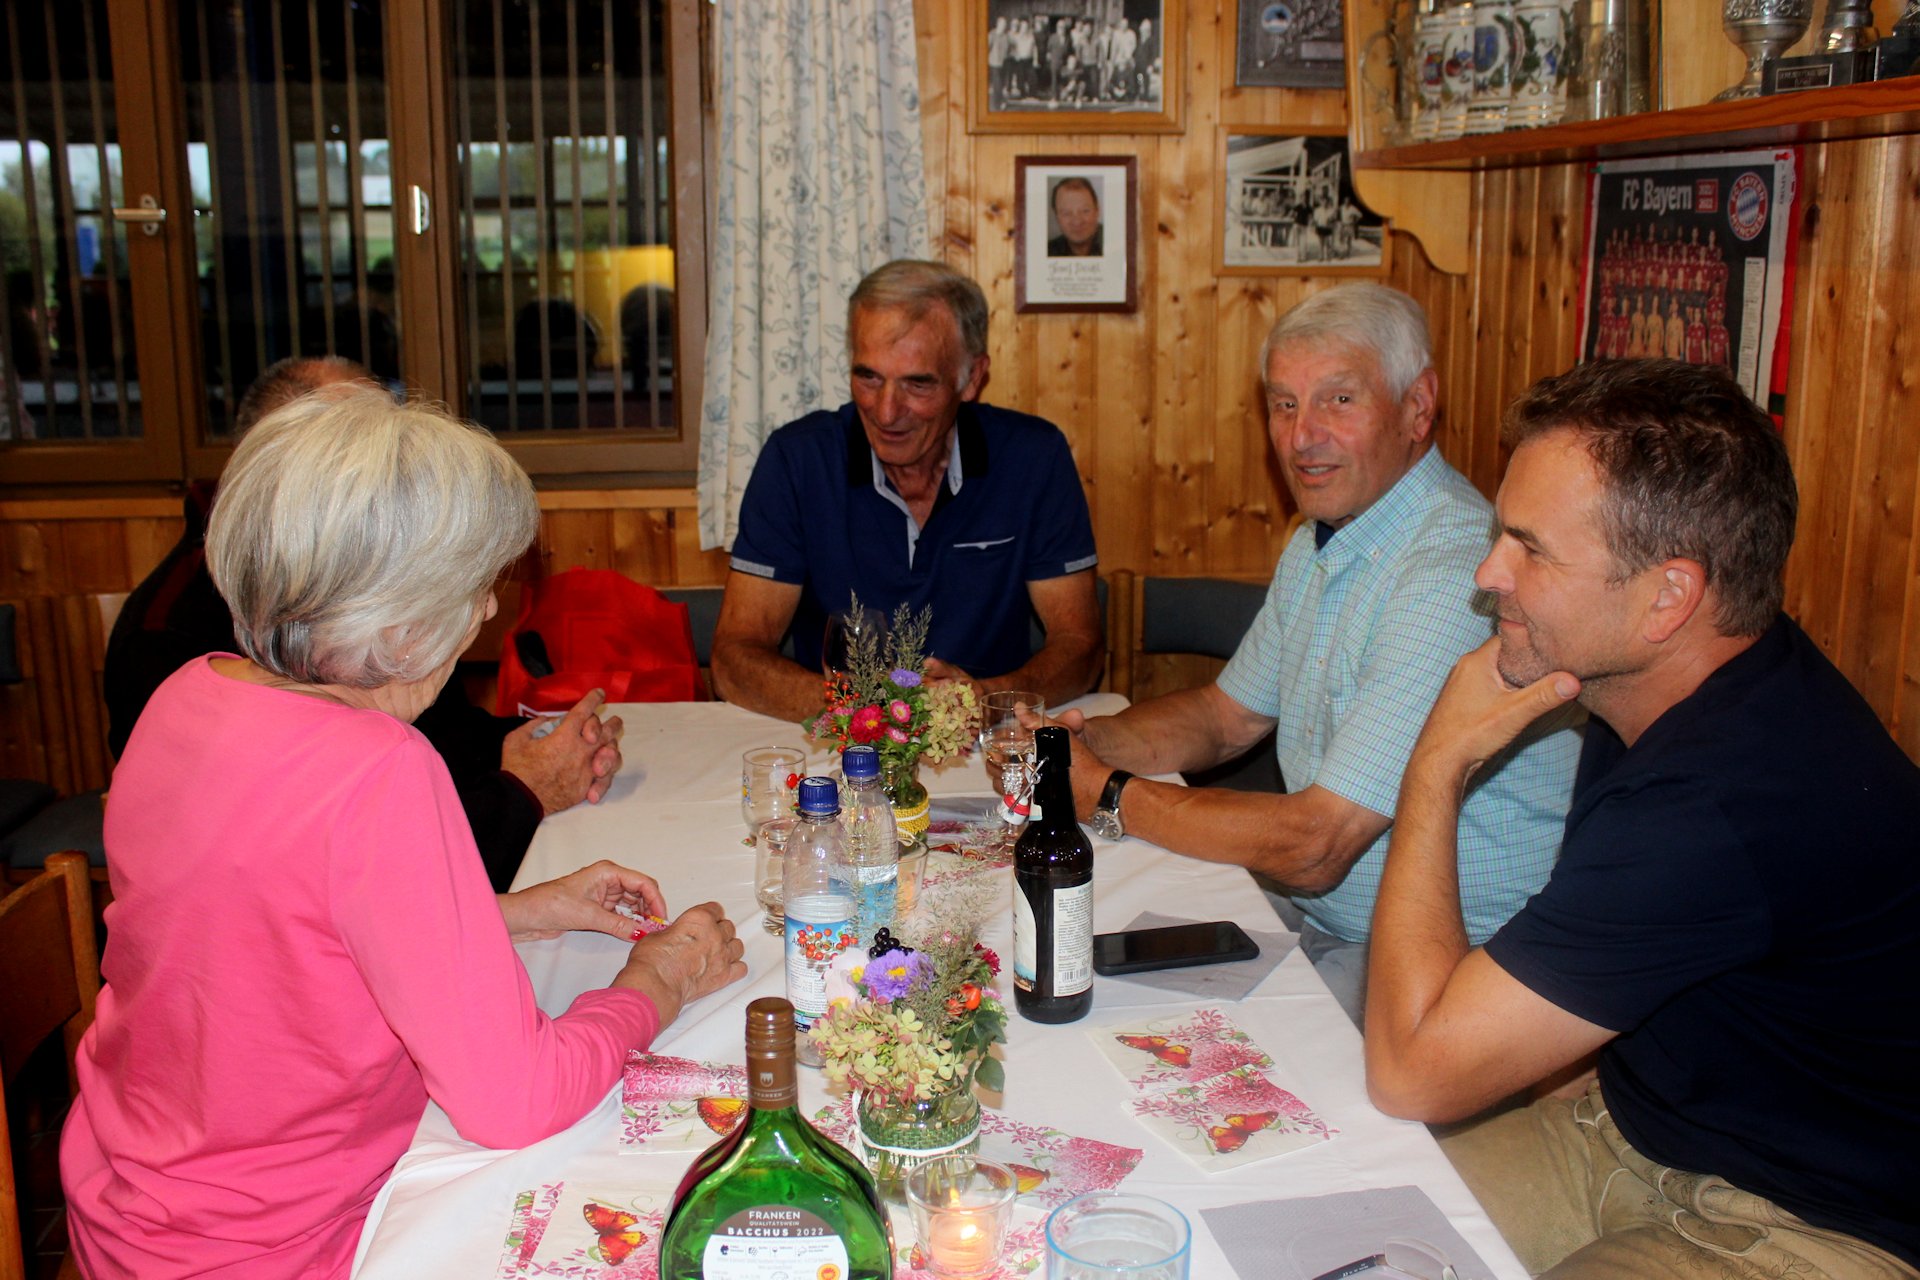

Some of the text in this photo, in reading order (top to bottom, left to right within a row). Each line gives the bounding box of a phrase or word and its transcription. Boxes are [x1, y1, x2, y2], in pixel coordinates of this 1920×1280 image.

[1621, 177, 1693, 216] FC Bayern
[748, 1210, 801, 1220] FRANKEN
[727, 1227, 824, 1237] BACCHUS 2022
